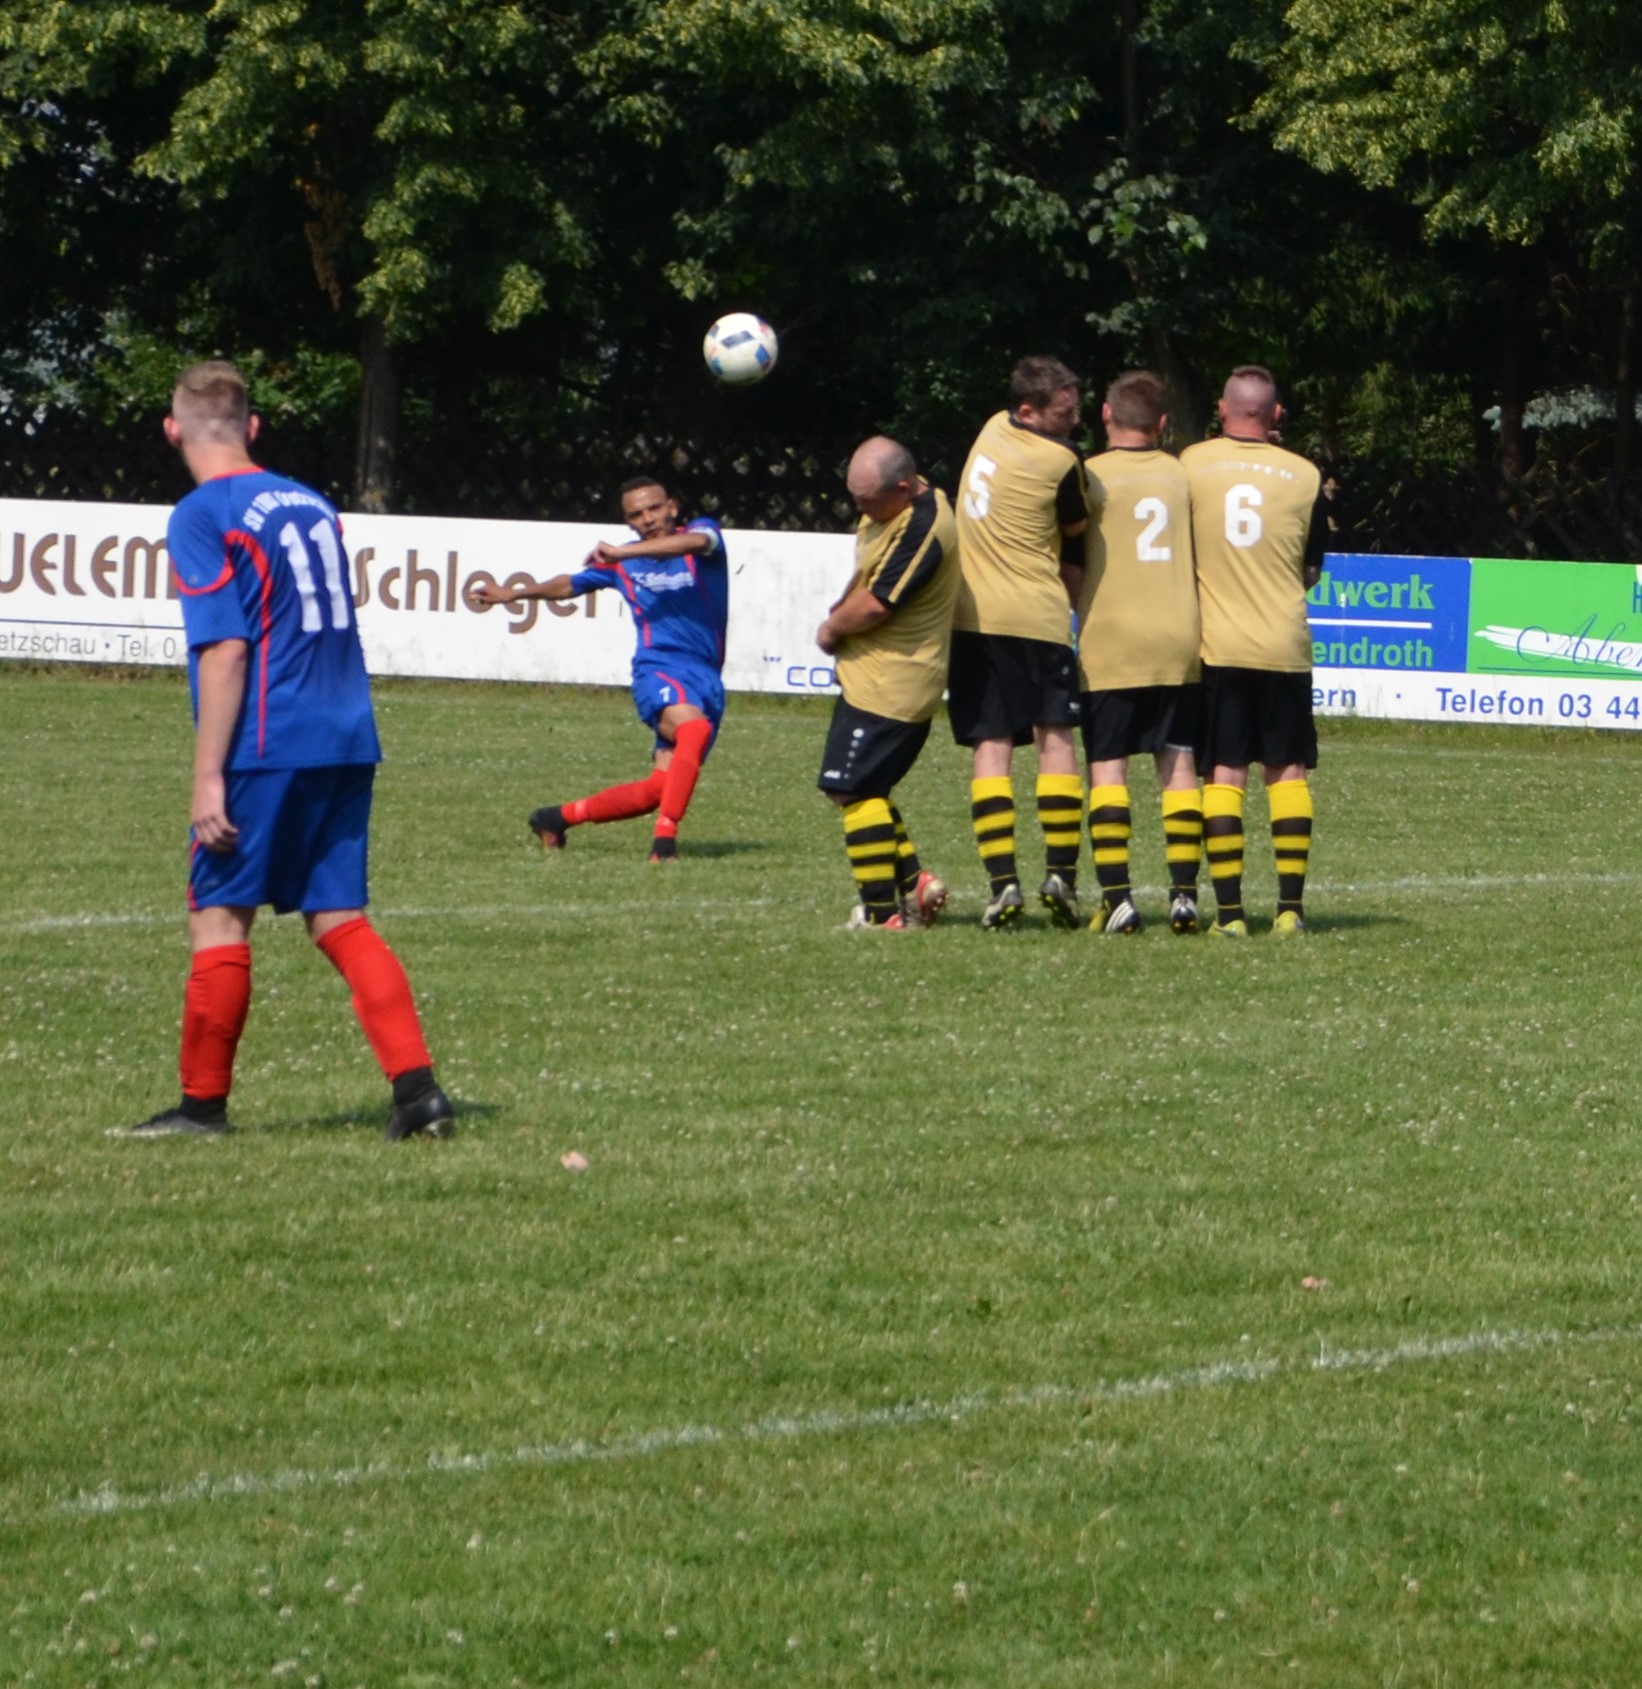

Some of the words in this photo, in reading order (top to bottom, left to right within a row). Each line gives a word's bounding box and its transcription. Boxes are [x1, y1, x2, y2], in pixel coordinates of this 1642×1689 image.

[964, 454, 997, 520] 5
[1224, 483, 1262, 547] 6
[1134, 497, 1171, 561] 2
[279, 518, 349, 632] 11
[117, 634, 155, 658] Tel.
[163, 637, 176, 659] 0
[1435, 687, 1544, 715] Telefon
[1558, 693, 1592, 719] 03
